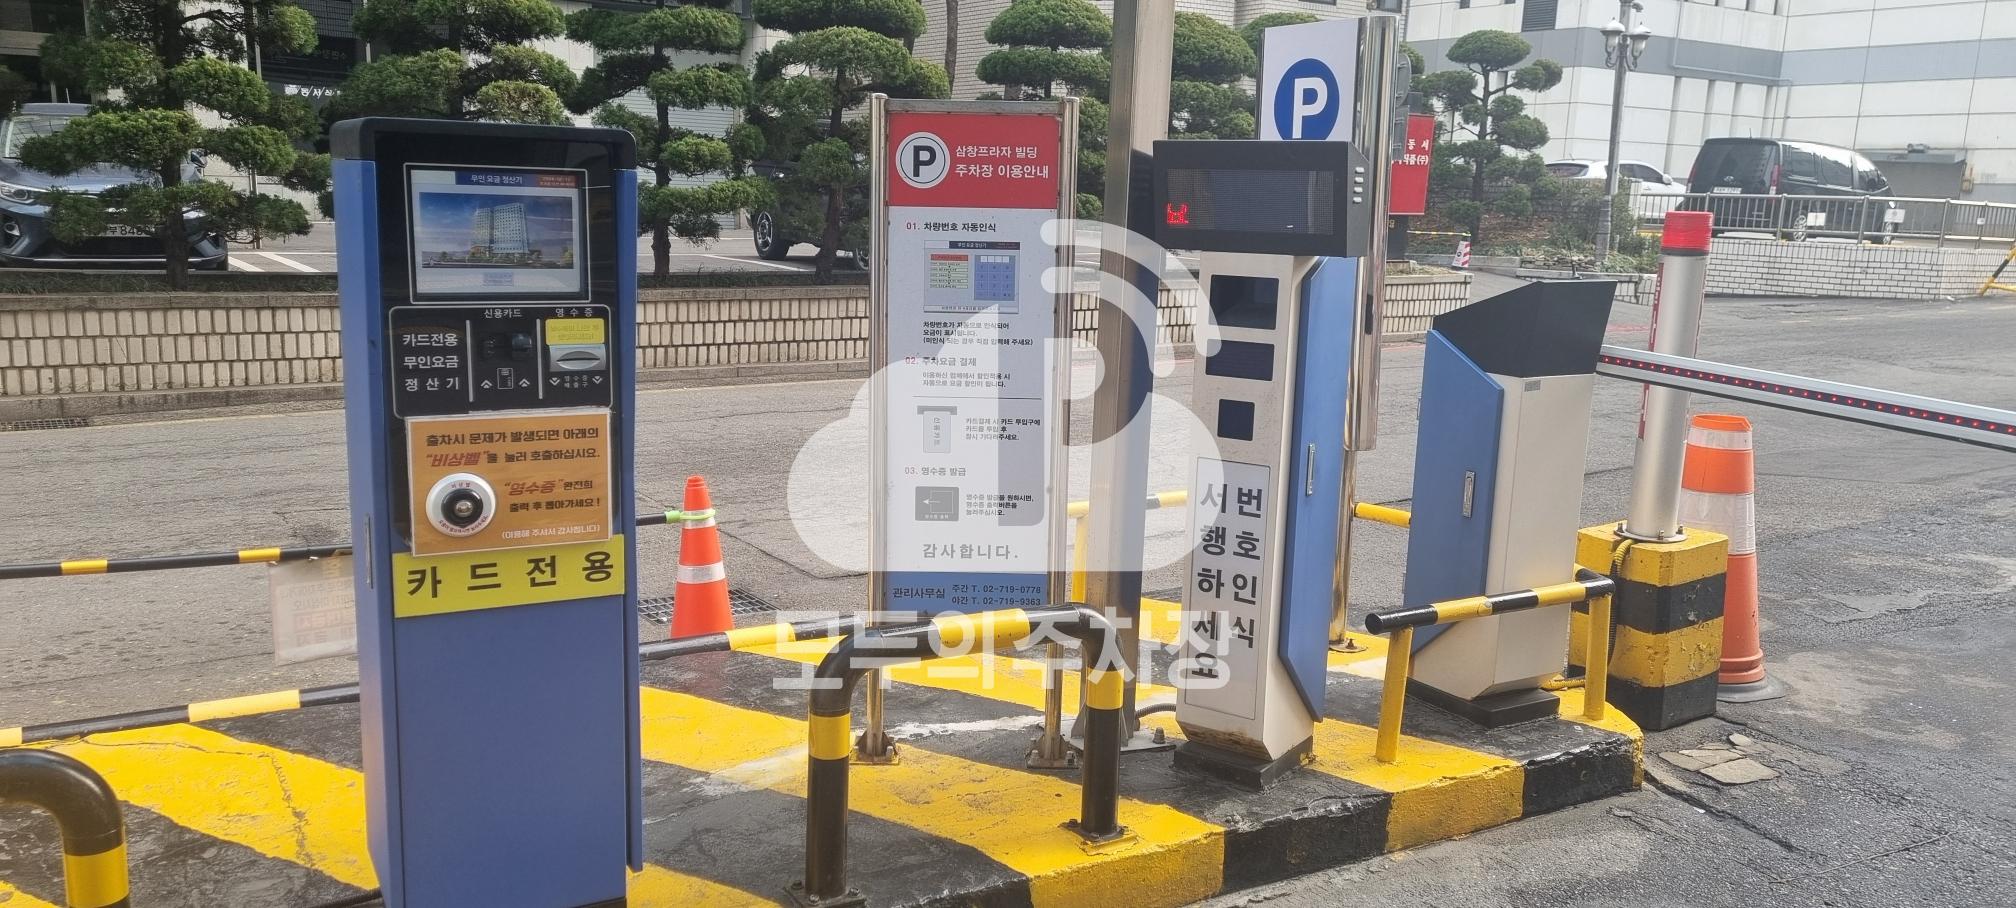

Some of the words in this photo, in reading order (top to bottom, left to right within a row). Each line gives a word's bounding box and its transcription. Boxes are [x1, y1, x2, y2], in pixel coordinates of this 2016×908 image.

[1292, 77, 1328, 139] P
[956, 145, 1011, 158] 삼창프라자
[1015, 146, 1037, 159] 빌딩
[912, 144, 937, 178] P
[955, 164, 993, 178] 주차장
[998, 164, 1049, 179] 이용안내
[471, 174, 486, 183] 무인
[502, 175, 523, 184] 정산기
[906, 222, 920, 231] 01.
[923, 222, 959, 232] 차량번호
[961, 222, 996, 233] 자동인식
[484, 308, 523, 319] 신용카드
[923, 321, 955, 329] 차량번호가
[402, 332, 458, 348] 카드전용
[1011, 338, 1034, 346] 주세요)
[403, 355, 459, 370] 무인요금
[922, 356, 956, 367] 주차요금
[404, 377, 459, 392] 정산기
[1015, 418, 1041, 426] 투입구에
[426, 433, 465, 447] 출차시
[469, 431, 507, 445] 문제가
[510, 429, 560, 443] 발생되면
[563, 427, 599, 440] 아래의
[504, 451, 527, 463] 눌러
[904, 467, 918, 475] 03.
[921, 466, 946, 476] 영수증
[949, 467, 966, 477] 발급
[532, 501, 542, 511] 후
[922, 543, 1019, 560] 감사합니다.
[1231, 486, 1263, 649] 번호인식
[407, 551, 614, 599] 카드전용
[1191, 483, 1228, 680] 서행하세요
[892, 587, 945, 599] 관리사무실
[951, 584, 969, 594] 주간
[971, 585, 980, 593] T.
[951, 596, 969, 606] 야간
[971, 597, 980, 605] T.
